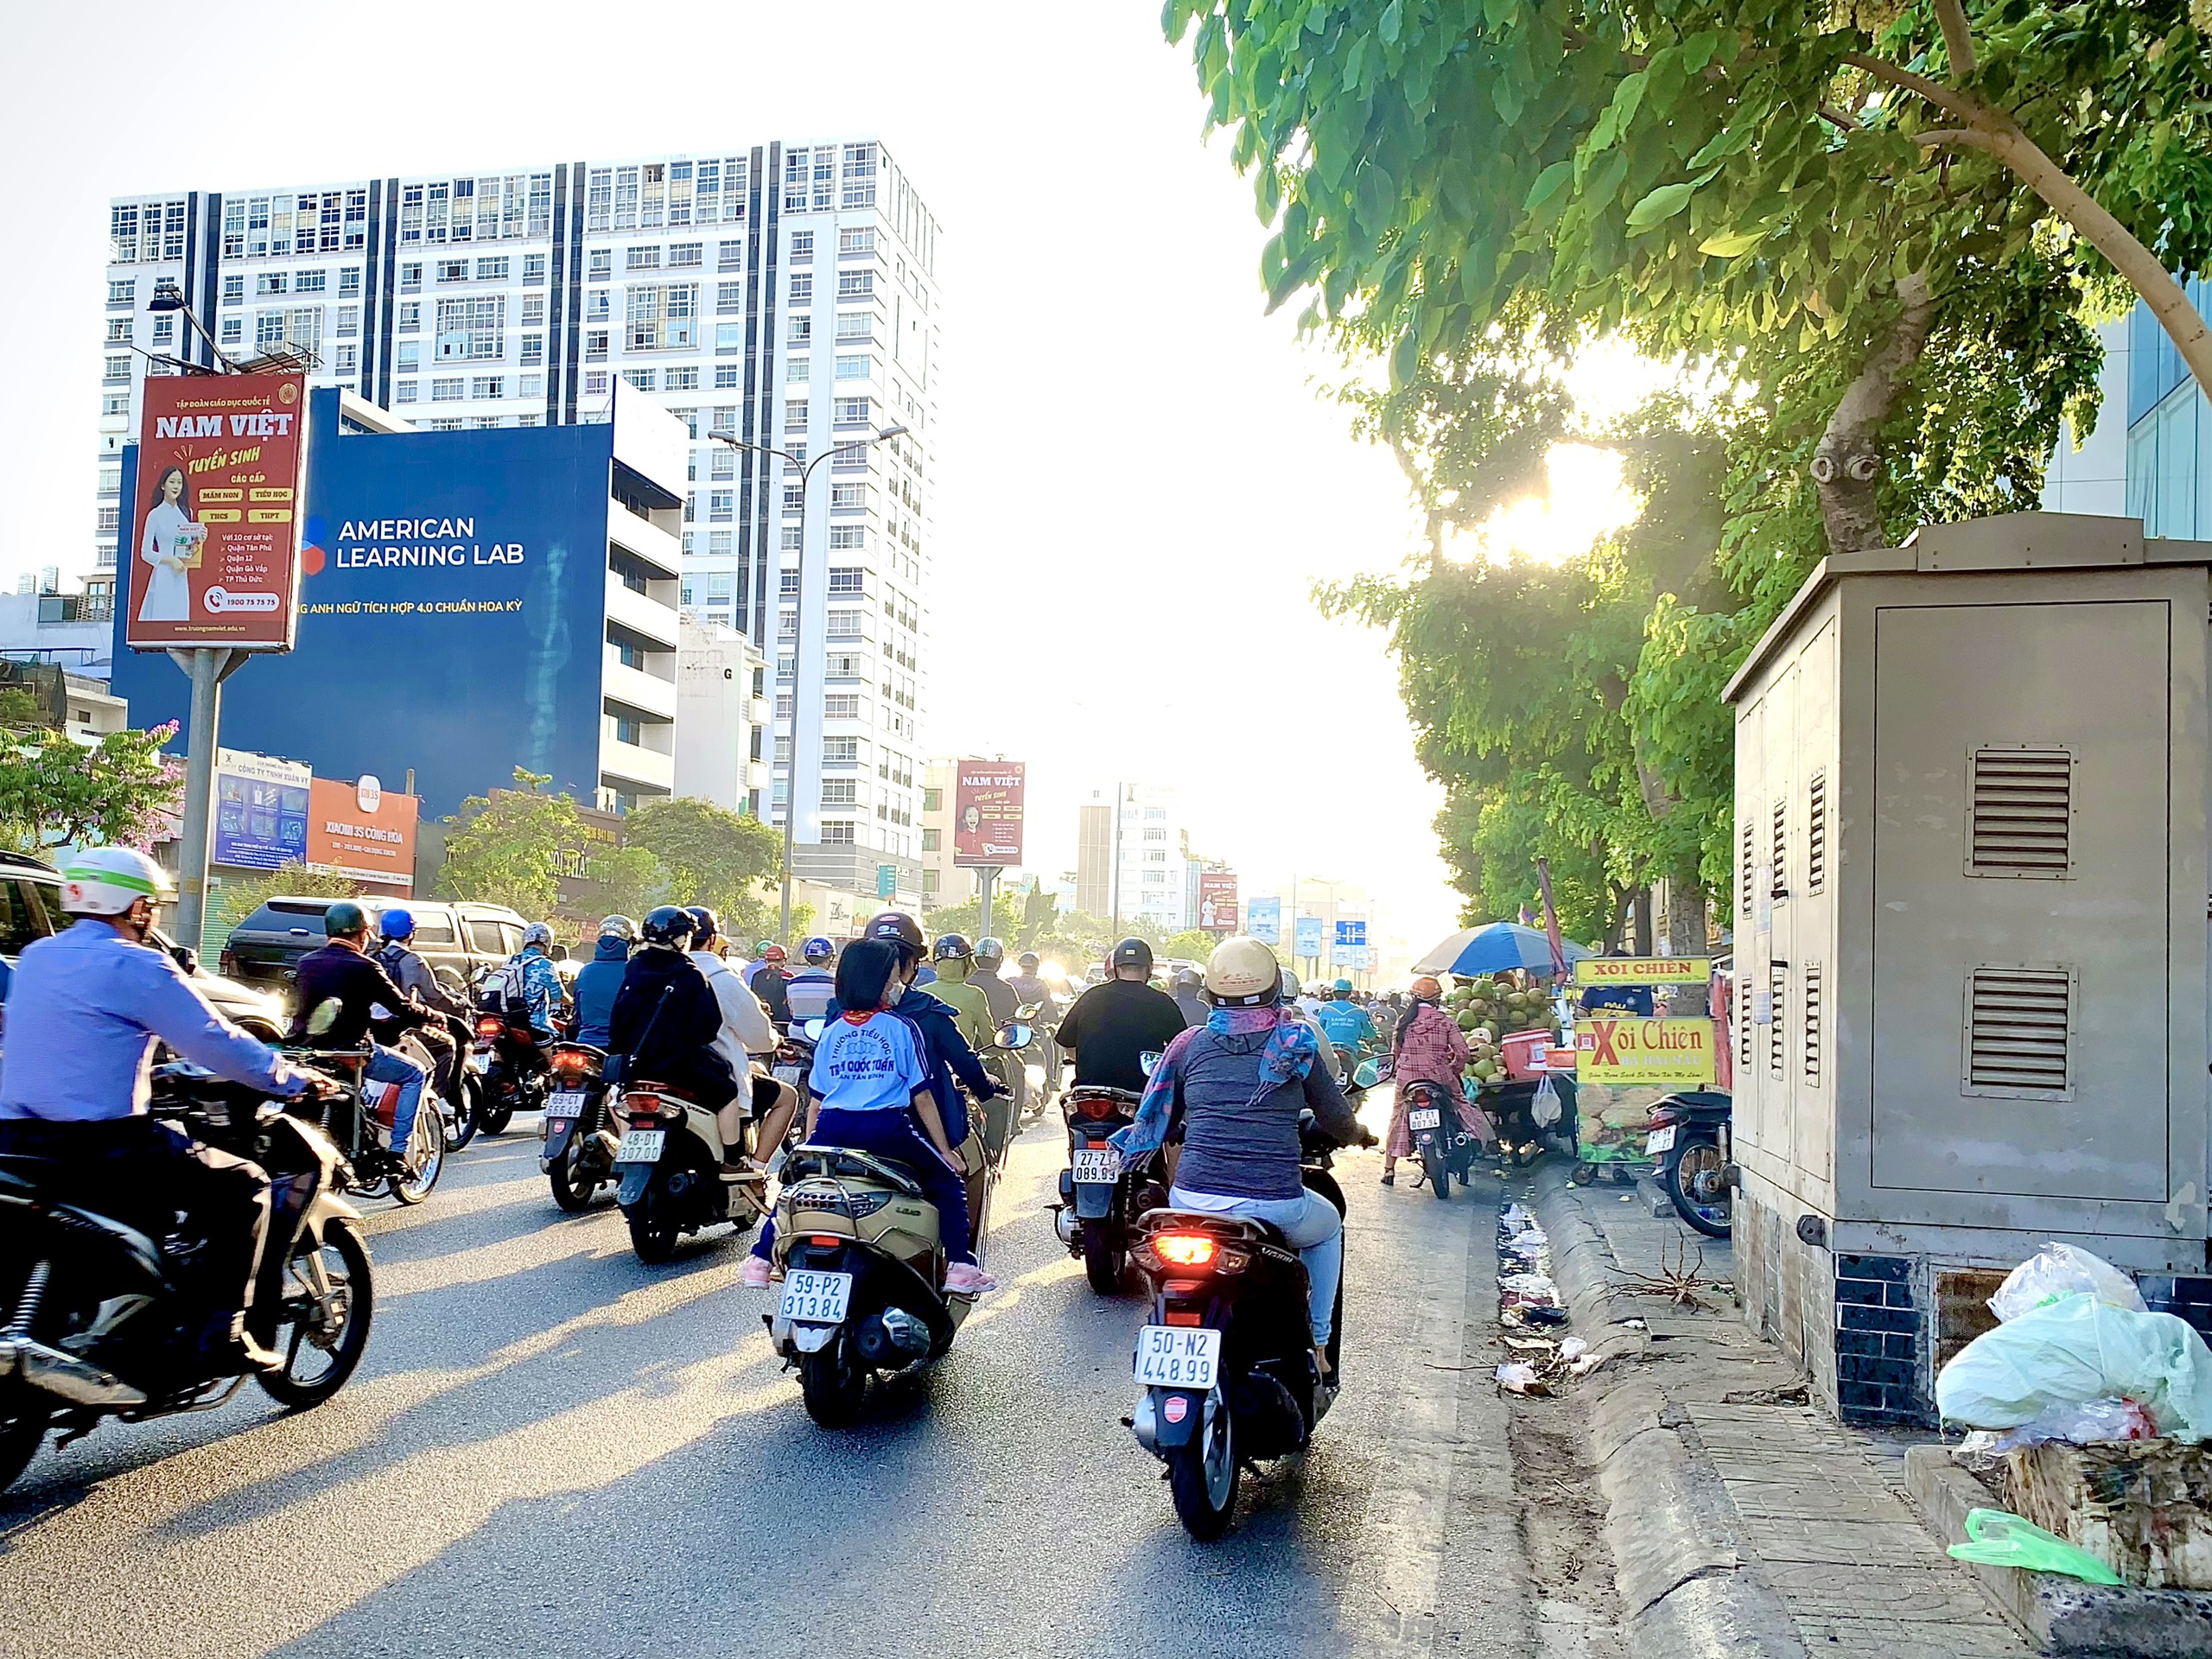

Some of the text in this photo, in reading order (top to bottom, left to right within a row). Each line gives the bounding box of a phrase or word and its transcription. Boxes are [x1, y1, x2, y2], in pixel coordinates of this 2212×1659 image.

[156, 408, 293, 442] NAM VIỆT
[230, 446, 261, 466] SINH
[231, 471, 266, 484] CÁC CẤP
[338, 517, 474, 541] AMERICAN
[337, 543, 524, 569] LEARNING LAB
[309, 603, 334, 613] ANH
[336, 601, 361, 613] NGỮ
[363, 600, 389, 613] TÍCH
[391, 601, 415, 615] HỢP
[416, 601, 433, 613] 4.0
[435, 598, 475, 613] CHUẨN
[479, 601, 504, 613] HOA
[505, 598, 523, 612] KỲ
[724, 669, 733, 679] G
[238, 764, 256, 775] CÔNG
[266, 770, 283, 779] TNHH
[963, 774, 1021, 788] NAM VIỆT
[325, 821, 403, 844] XIAOMI 3S CỘNG HÒA
[1593, 959, 1692, 976] XÔI CHIÊN
[878, 1037, 892, 1055] HỌC
[1591, 1020, 1703, 1066] Xôi Chiên
[847, 1056, 871, 1073] QUỐC
[546, 1106, 580, 1116] 666.42
[627, 1133, 657, 1146] 48-D1
[620, 1147, 658, 1160] 307.00
[1262, 1246, 1294, 1264] VISION
[795, 1274, 842, 1296] 59-P2
[785, 1296, 842, 1319] 313.84
[1151, 1331, 1208, 1357] 50-N2
[1142, 1357, 1211, 1382] 448.99
